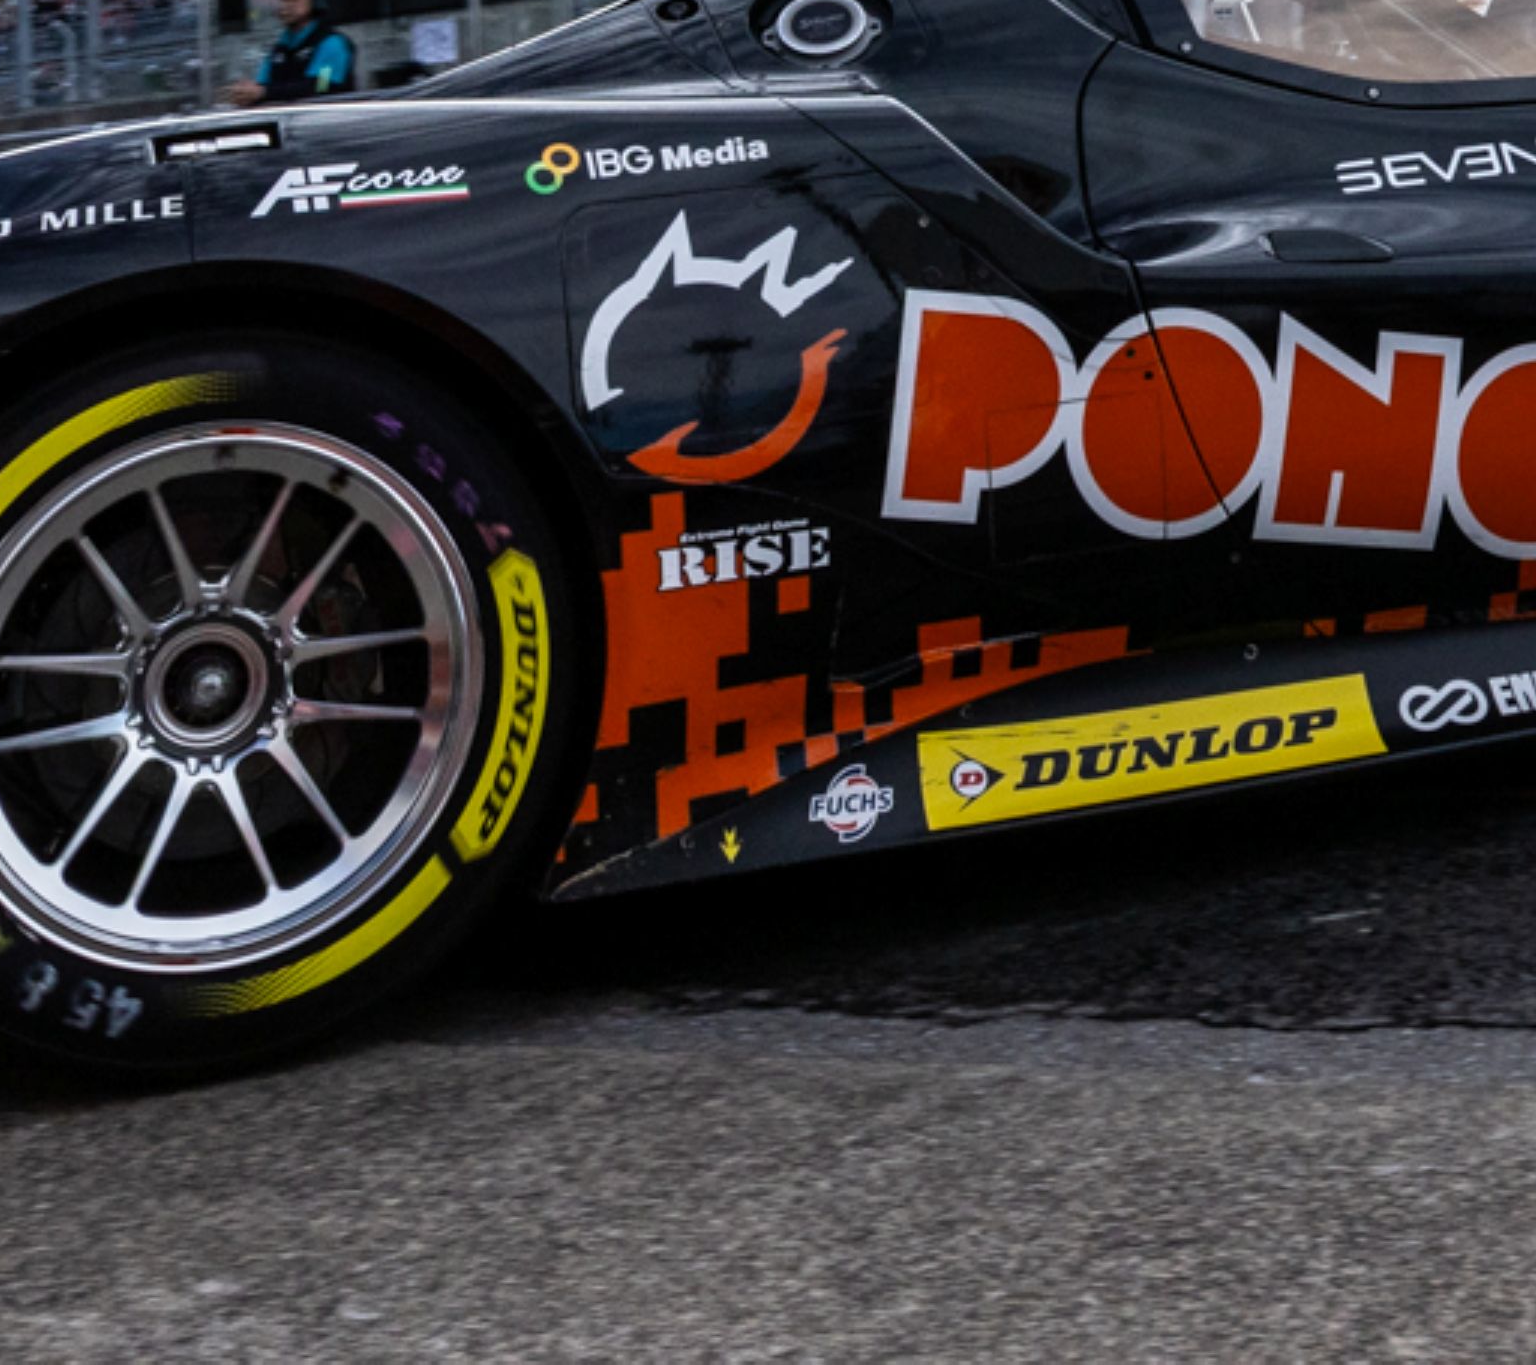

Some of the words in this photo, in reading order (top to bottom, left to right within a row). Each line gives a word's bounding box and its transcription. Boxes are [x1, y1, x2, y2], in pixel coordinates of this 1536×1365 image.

[584, 145, 653, 180] IBG
[661, 137, 768, 172] Media
[40, 194, 184, 232] MILLE
[250, 162, 357, 219] AF
[347, 164, 465, 192] corse
[658, 526, 831, 592] RISE
[479, 598, 540, 842] DUNLOP
[1014, 707, 1337, 791] DUNLOP
[811, 790, 892, 818] FUCHS
